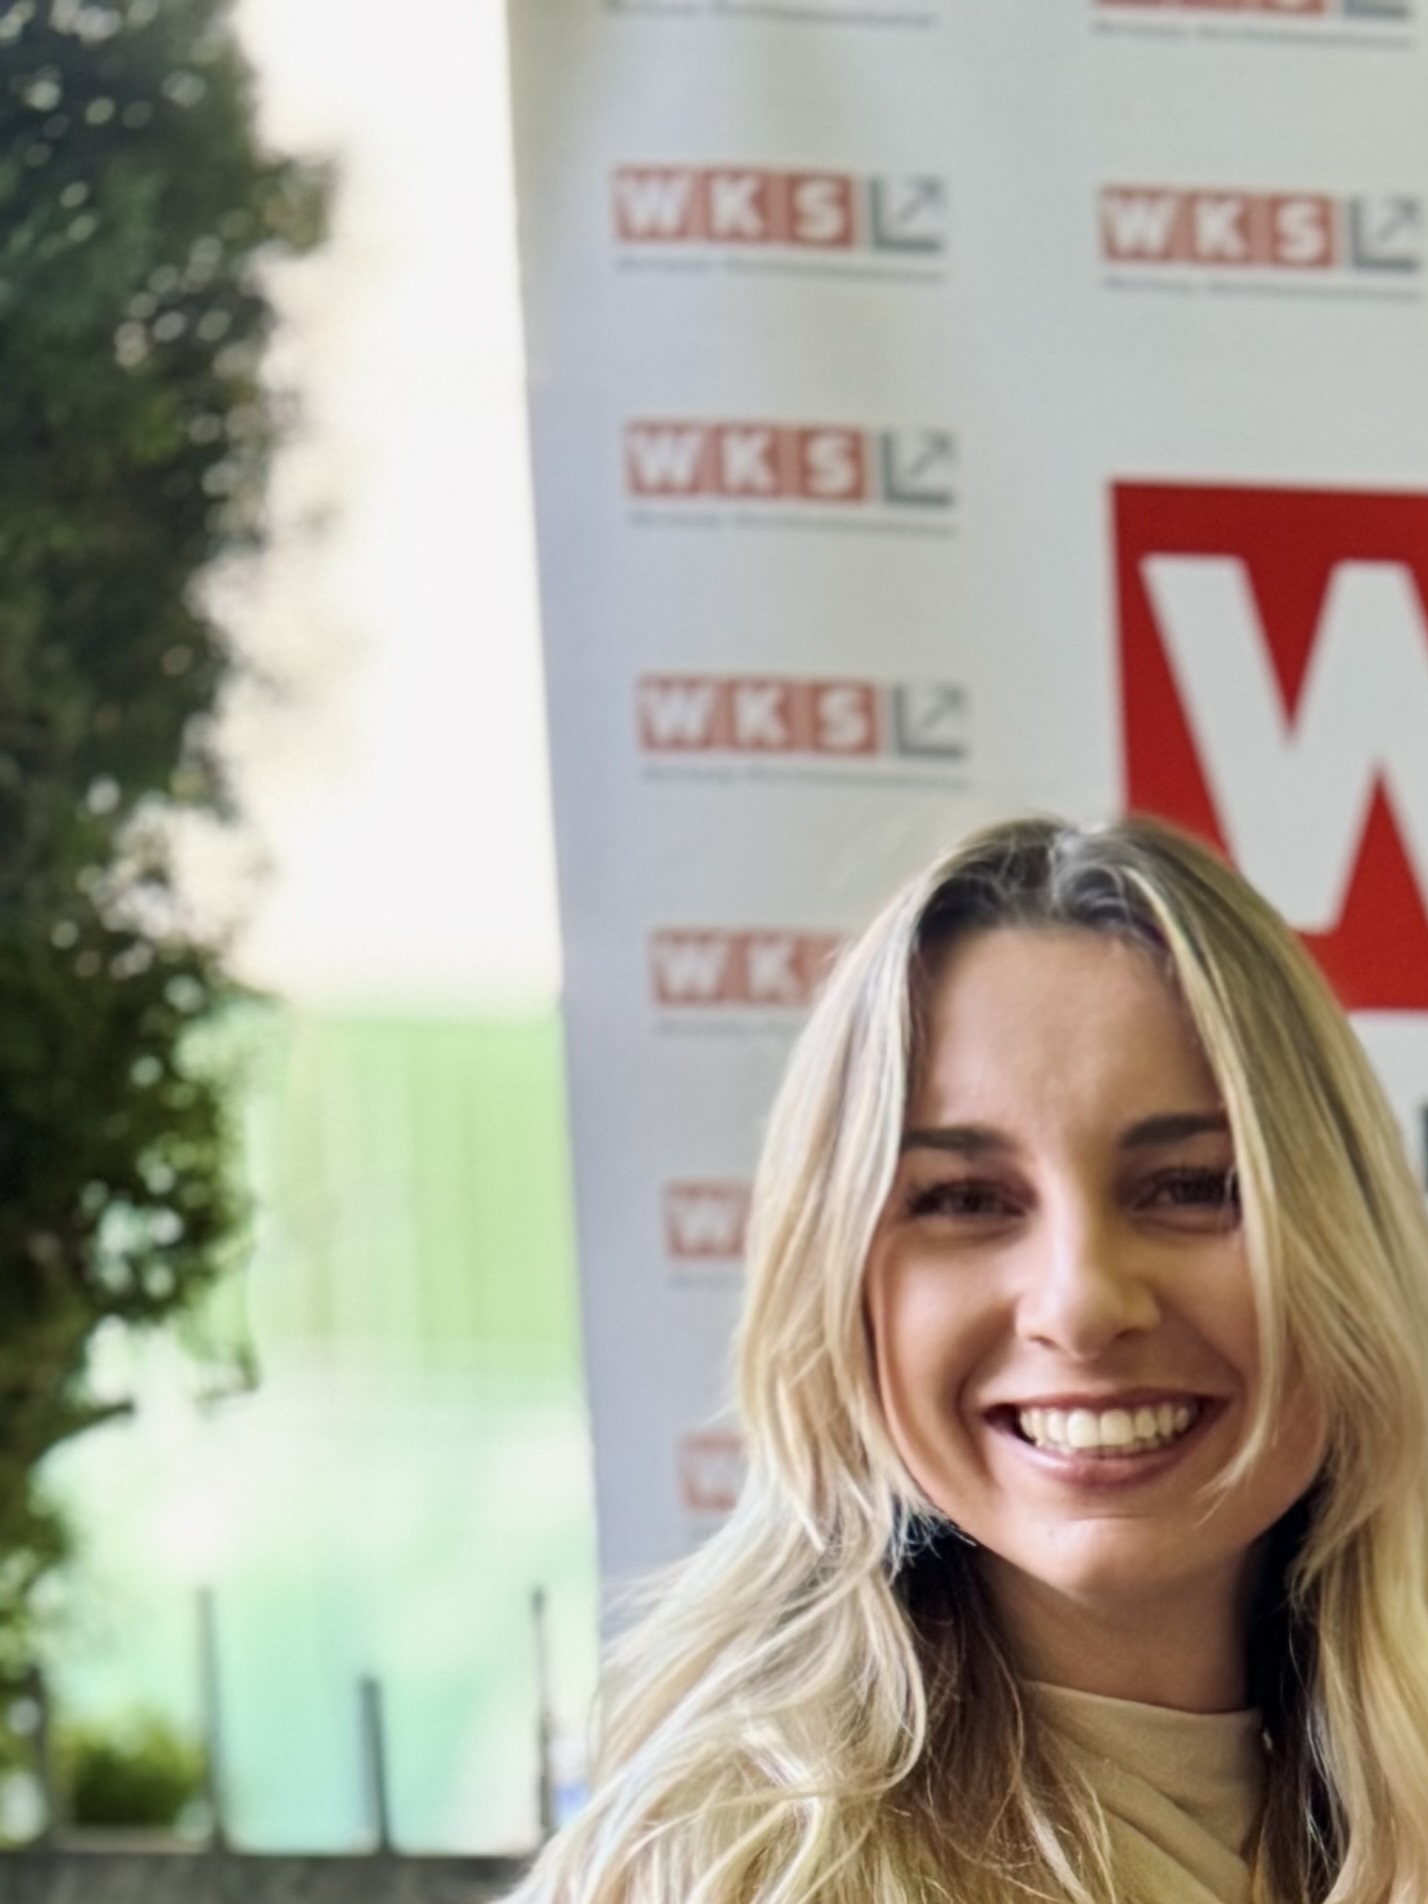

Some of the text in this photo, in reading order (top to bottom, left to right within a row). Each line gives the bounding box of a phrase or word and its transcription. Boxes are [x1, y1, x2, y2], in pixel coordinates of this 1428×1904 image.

[620, 177, 846, 239] WKS
[1107, 198, 1326, 259] WKS
[631, 432, 859, 494] WKS
[643, 687, 871, 748] WKS
[653, 936, 797, 998] WK
